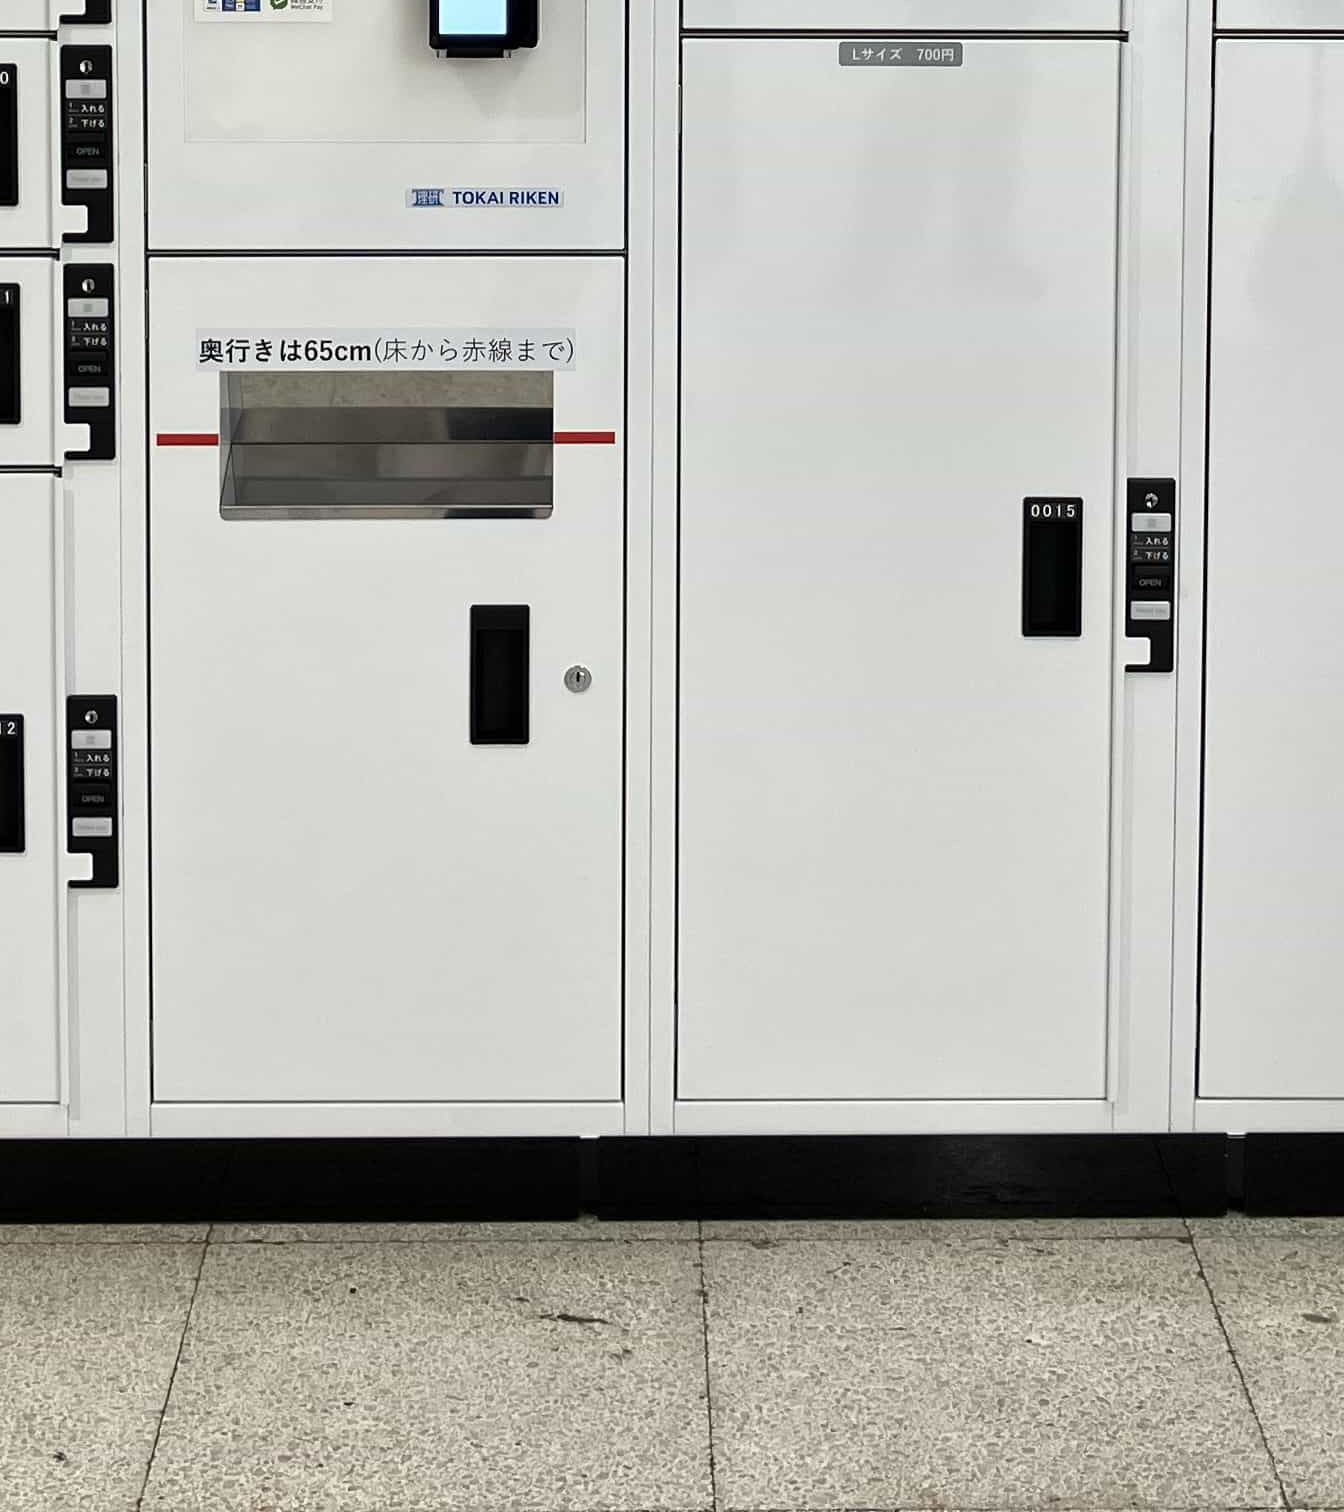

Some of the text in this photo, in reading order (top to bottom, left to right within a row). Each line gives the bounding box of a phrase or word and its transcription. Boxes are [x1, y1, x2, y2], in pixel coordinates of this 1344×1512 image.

[852, 48, 954, 61] Lサイズ 700円
[452, 191, 558, 204] TOKAI RIKEN
[1031, 505, 1075, 517] 0015
